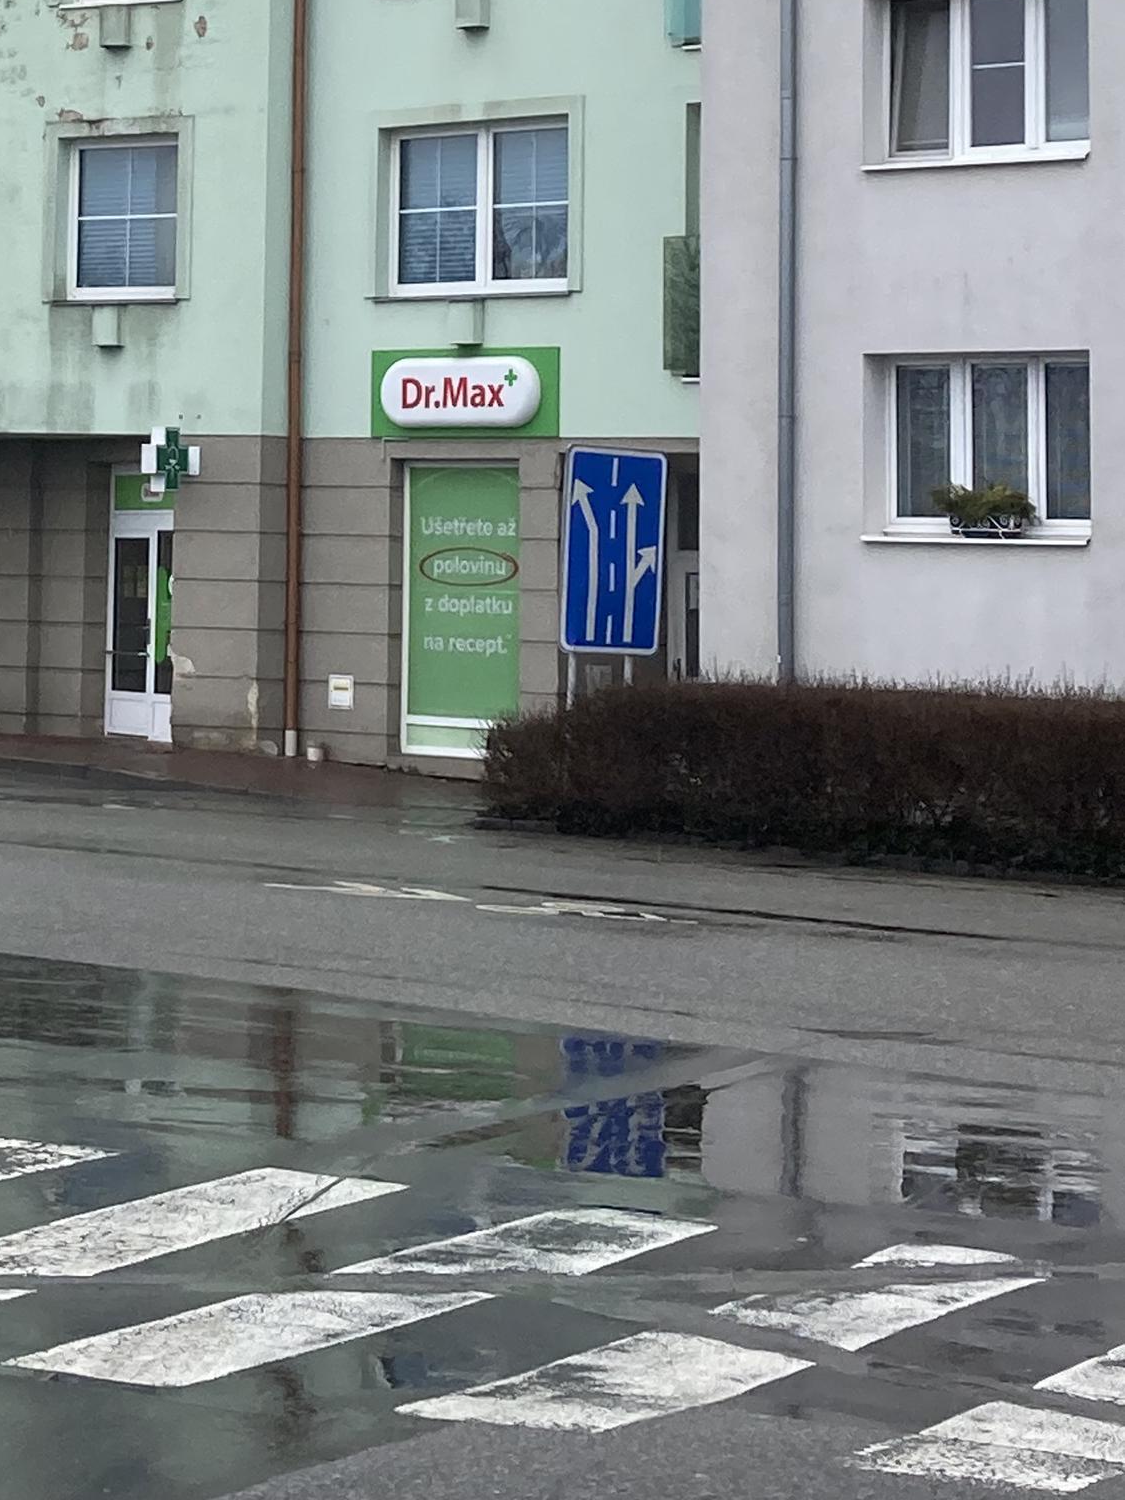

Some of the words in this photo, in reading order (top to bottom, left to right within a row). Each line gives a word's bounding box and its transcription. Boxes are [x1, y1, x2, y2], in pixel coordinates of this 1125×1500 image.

[401, 376, 505, 410] Dr.Max
[420, 516, 493, 536] Ušetřete
[497, 517, 516, 536] až
[433, 556, 506, 577] polovinu
[425, 597, 433, 612] z
[438, 594, 513, 617] doplatku
[423, 636, 444, 651] na
